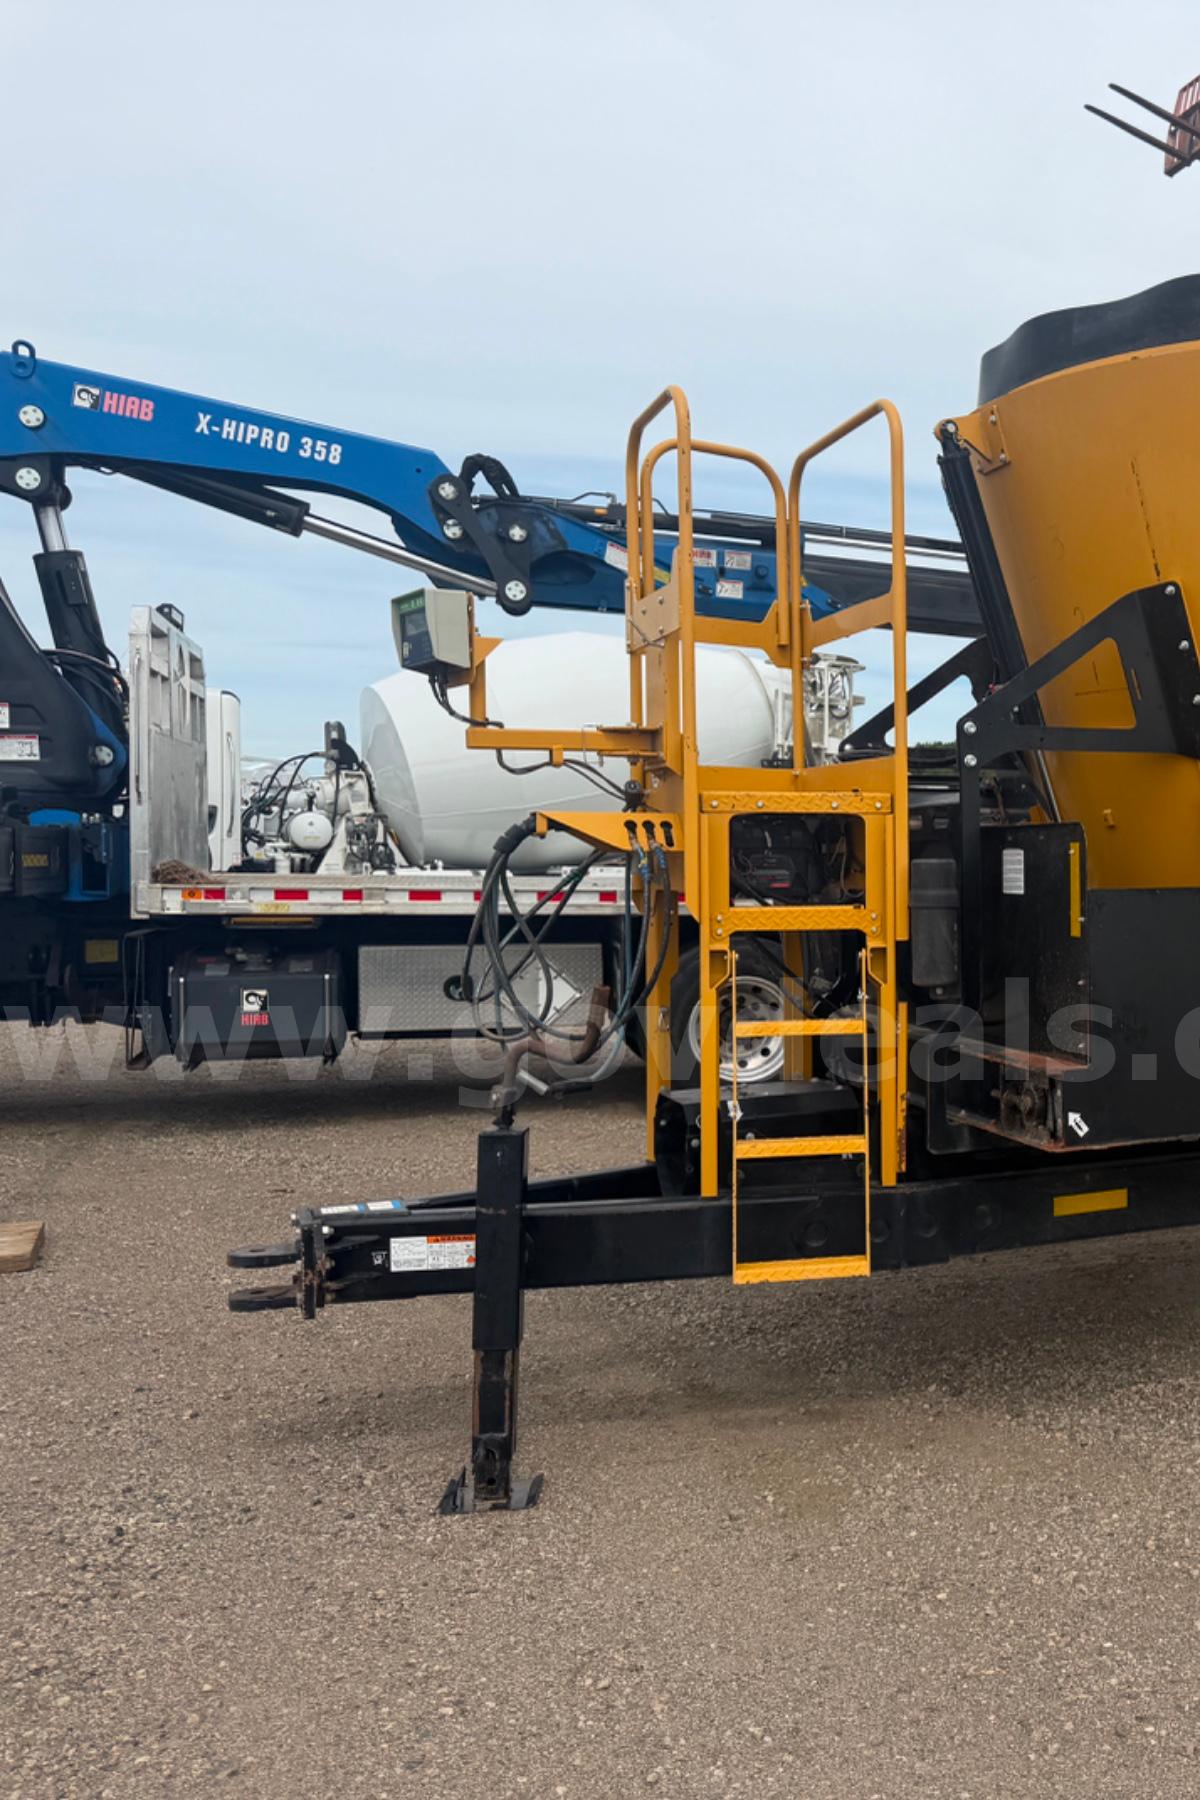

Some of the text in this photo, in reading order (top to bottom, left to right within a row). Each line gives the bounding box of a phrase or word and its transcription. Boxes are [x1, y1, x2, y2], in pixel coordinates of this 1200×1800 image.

[103, 391, 155, 421] HIAB
[195, 412, 342, 465] X-HIPRO 358
[241, 1013, 269, 1026] HIAB
